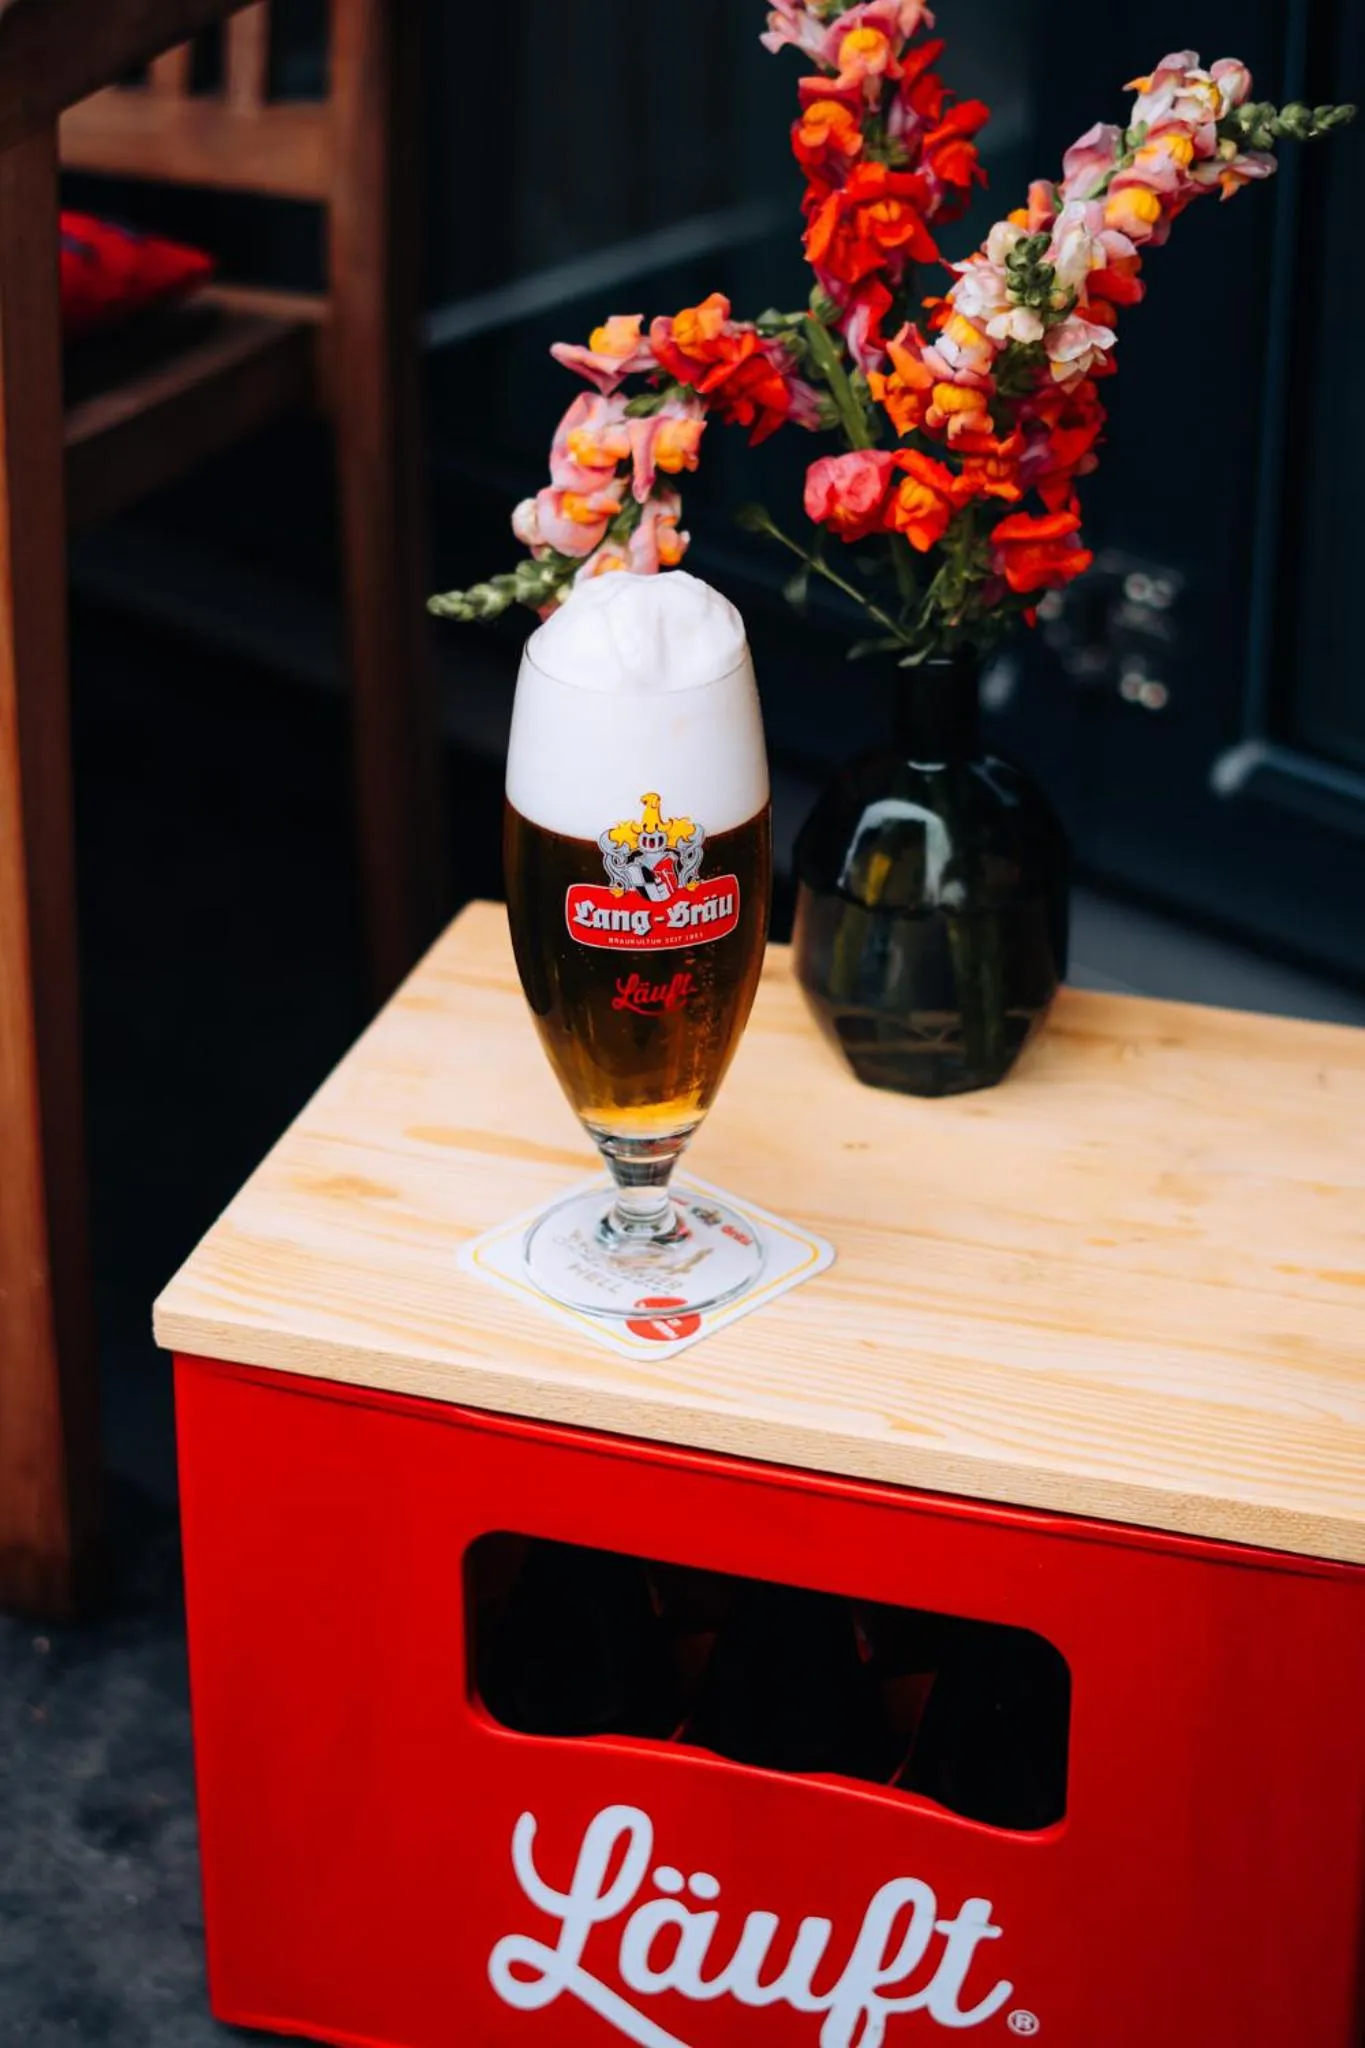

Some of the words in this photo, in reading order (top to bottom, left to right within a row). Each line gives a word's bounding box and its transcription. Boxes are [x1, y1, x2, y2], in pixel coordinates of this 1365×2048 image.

[665, 935, 682, 944] SEIT
[611, 972, 698, 1016] Läuft
[488, 1804, 1013, 2048] Läuft
